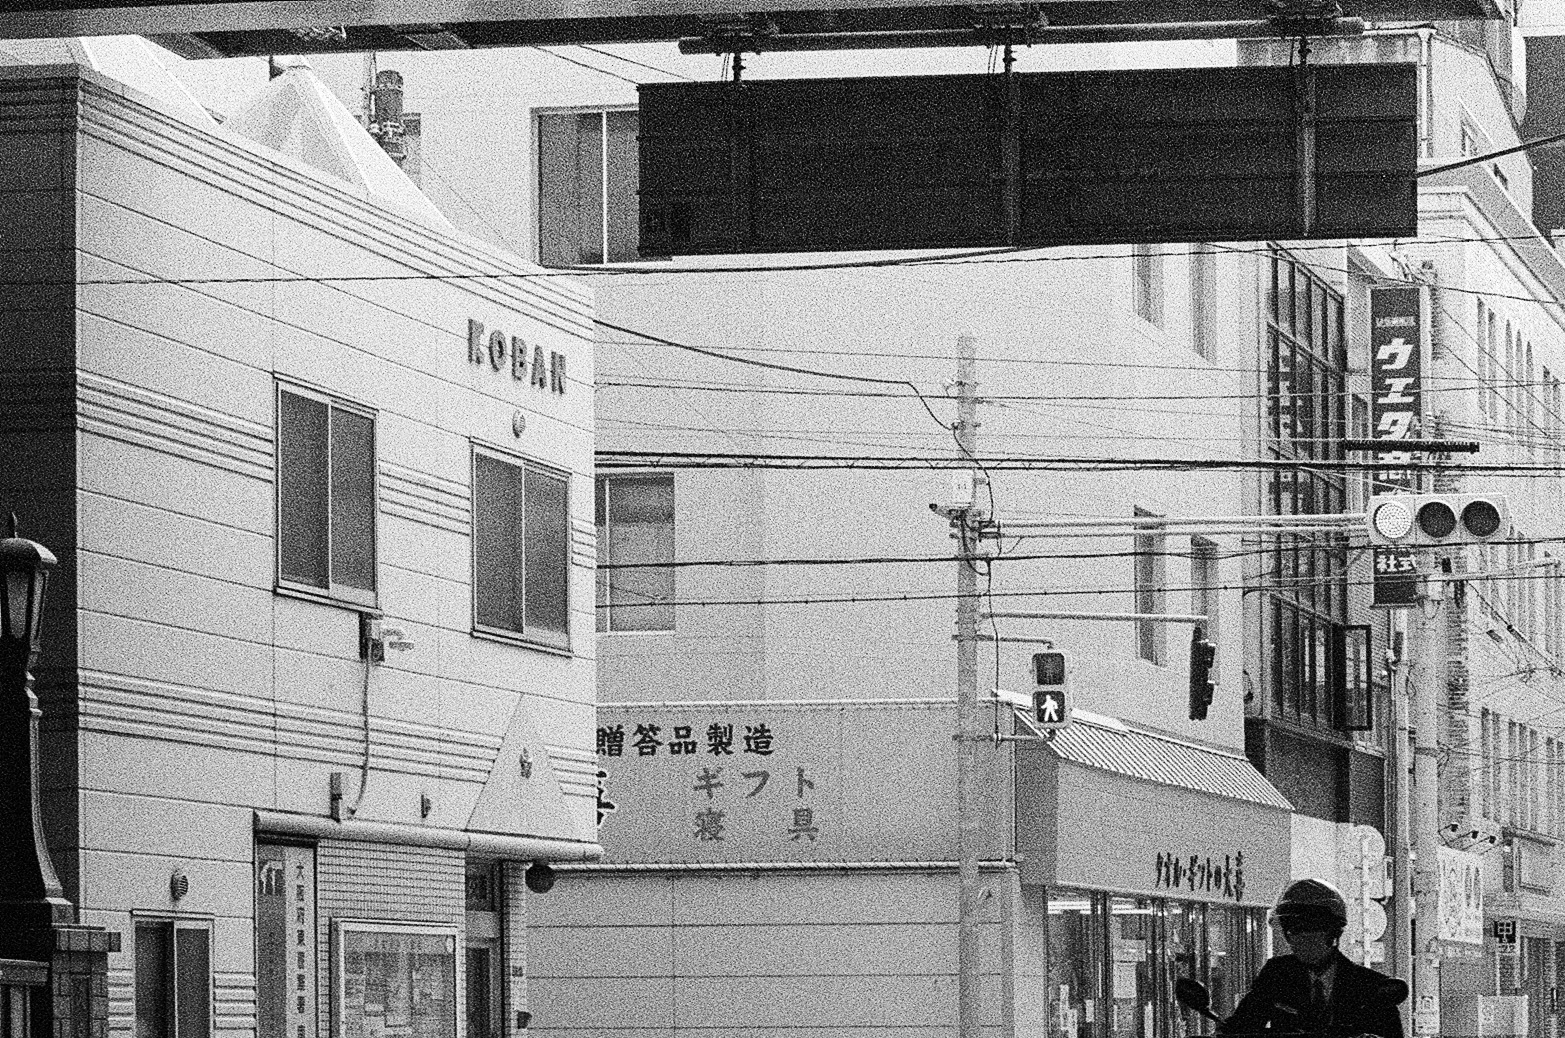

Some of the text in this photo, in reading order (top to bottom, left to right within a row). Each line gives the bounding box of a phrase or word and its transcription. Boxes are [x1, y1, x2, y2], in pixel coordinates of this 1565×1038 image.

[467, 319, 566, 395] KOBAN
[597, 722, 774, 757] 贈答品製造
[693, 766, 815, 799] ギフト
[692, 808, 819, 842] 寝具
